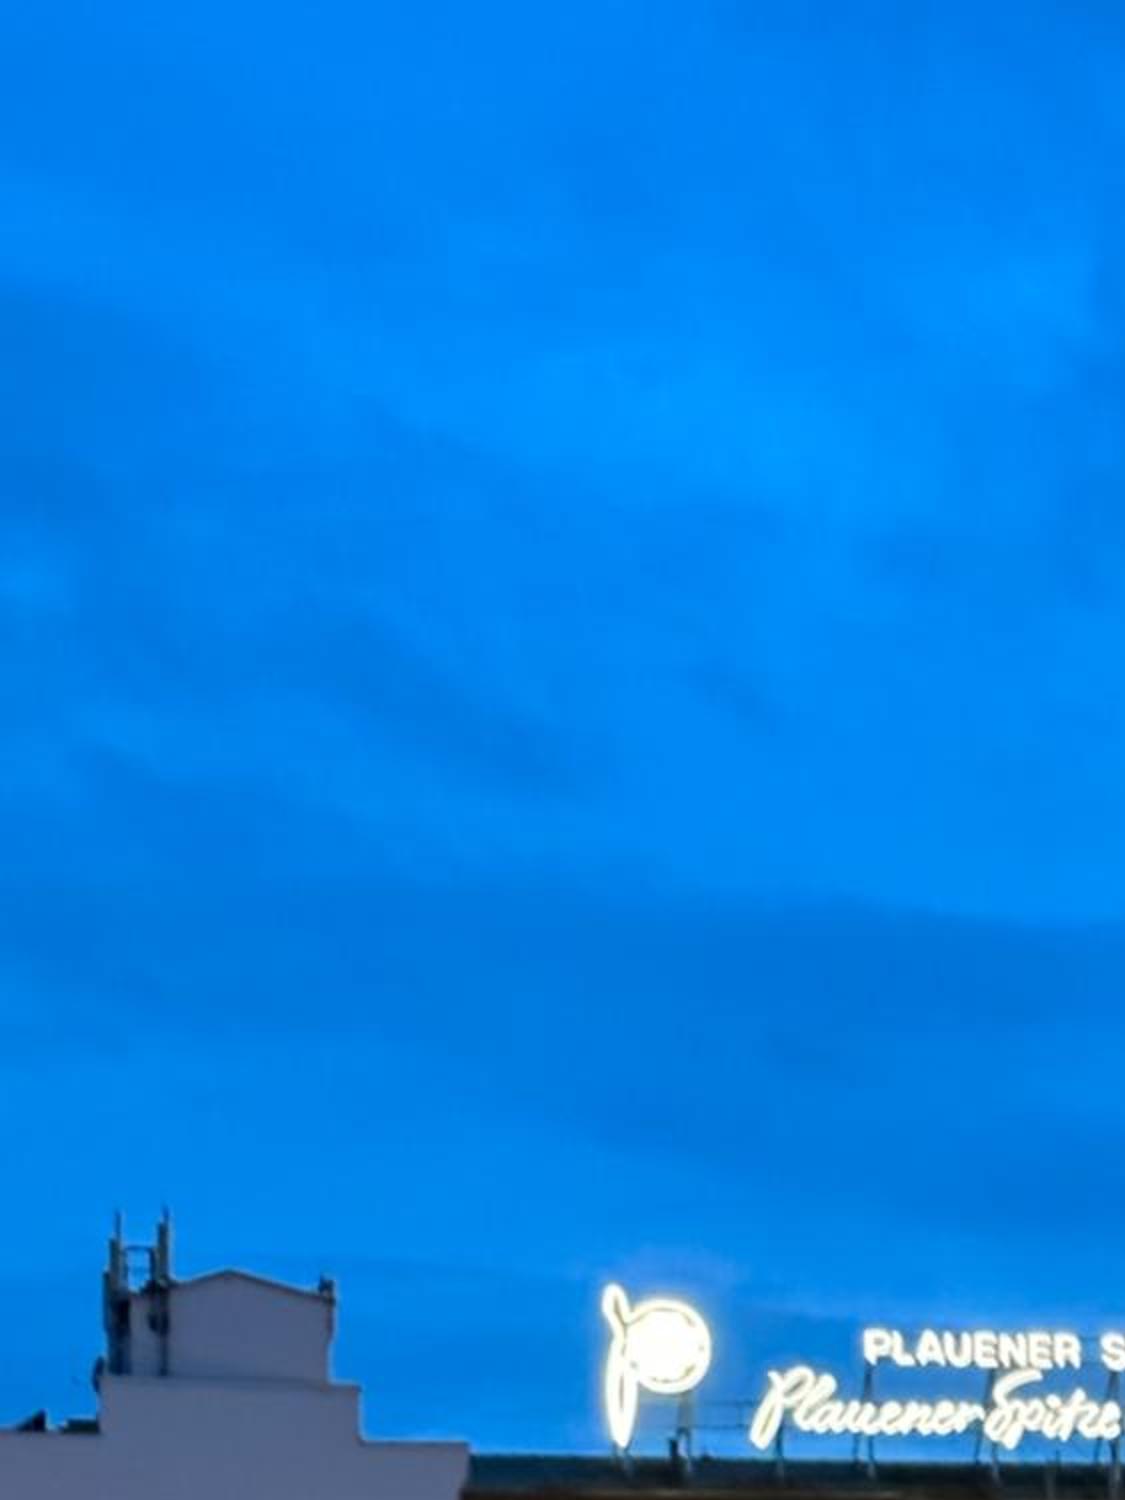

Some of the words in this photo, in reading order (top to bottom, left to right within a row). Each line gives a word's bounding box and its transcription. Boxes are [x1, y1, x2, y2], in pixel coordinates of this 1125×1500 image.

[862, 1329, 1082, 1369] PLAUENER
[750, 1366, 984, 1448] Plauener
[984, 1369, 1121, 1448] Spitze
